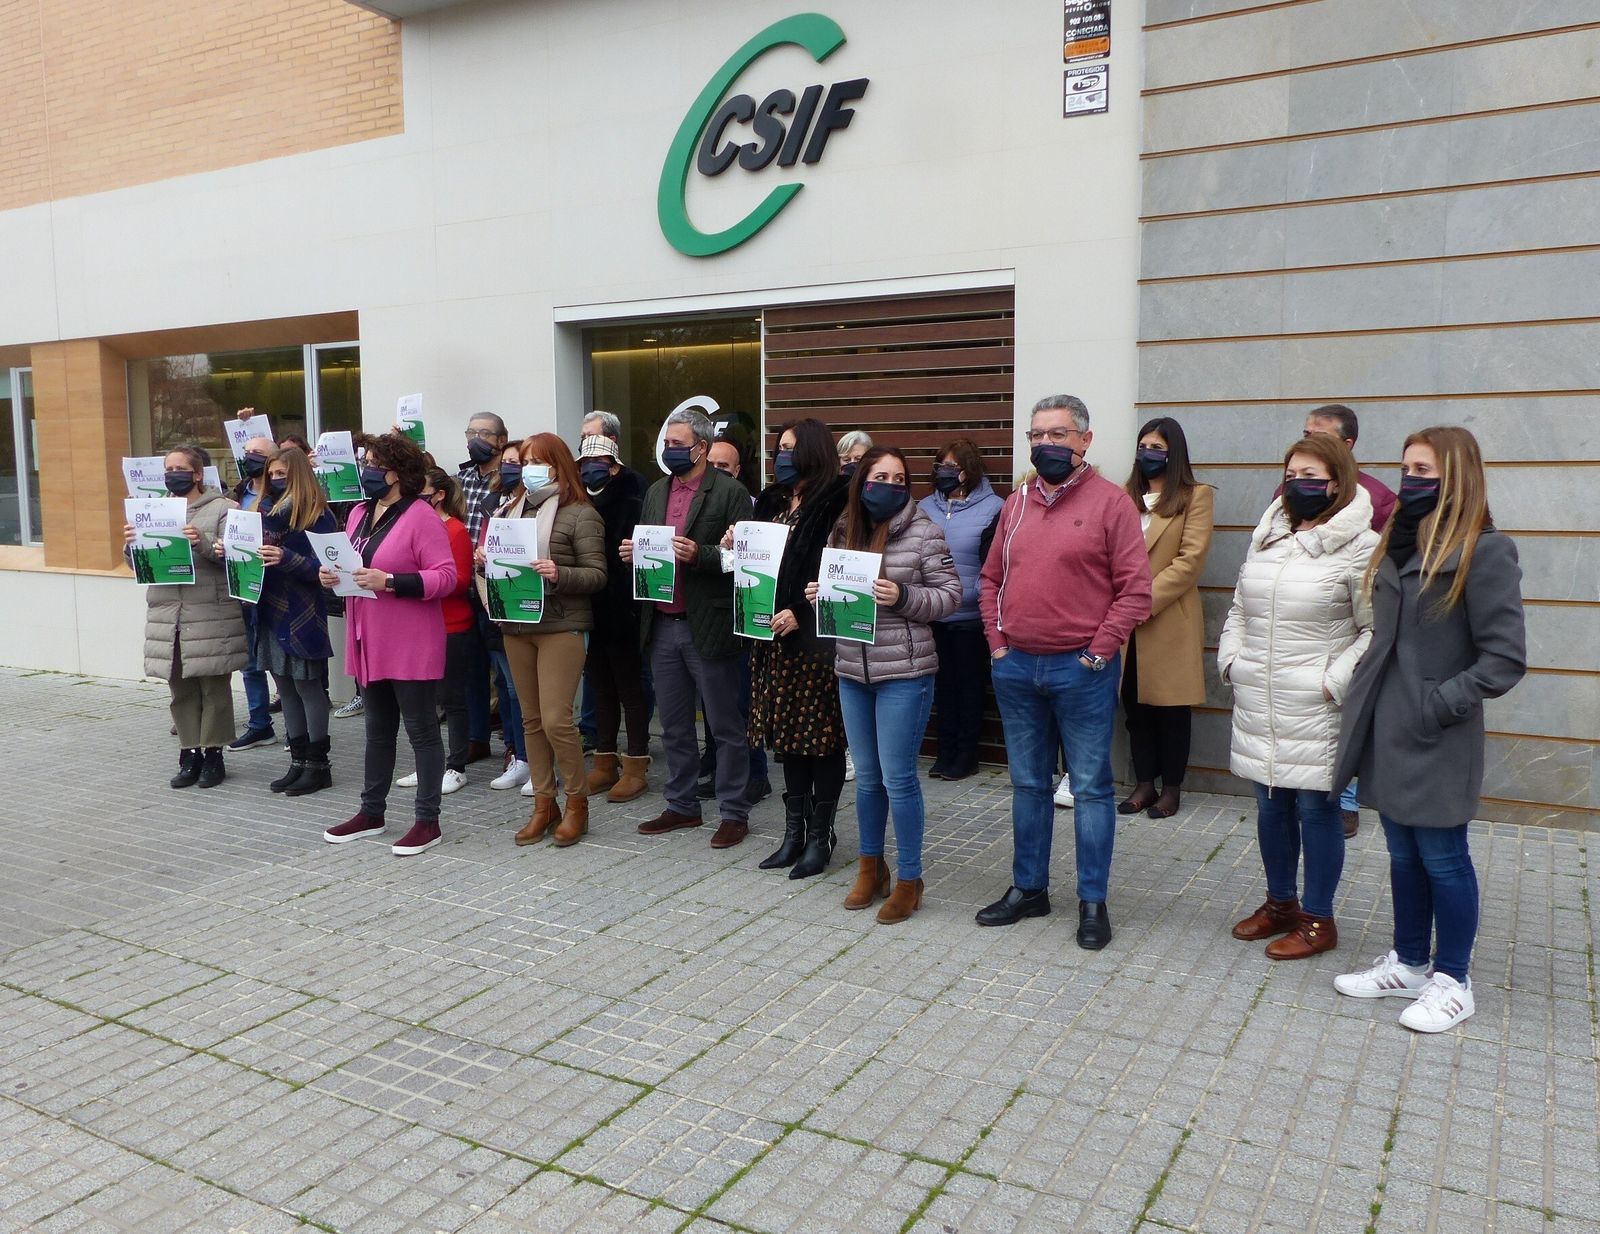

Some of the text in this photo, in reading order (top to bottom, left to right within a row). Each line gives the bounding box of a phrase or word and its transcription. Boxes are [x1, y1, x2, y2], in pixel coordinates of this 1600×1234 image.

[1066, 24, 1109, 37] CONECTADA
[1068, 66, 1105, 76] PROTEGIDO
[697, 78, 871, 177] CSIF
[130, 470, 144, 478] 8M
[136, 513, 151, 522] 8M
[487, 536, 500, 546] 8M
[638, 538, 650, 546] 8M
[737, 540, 748, 552] 8M
[828, 564, 844, 574] 8M
